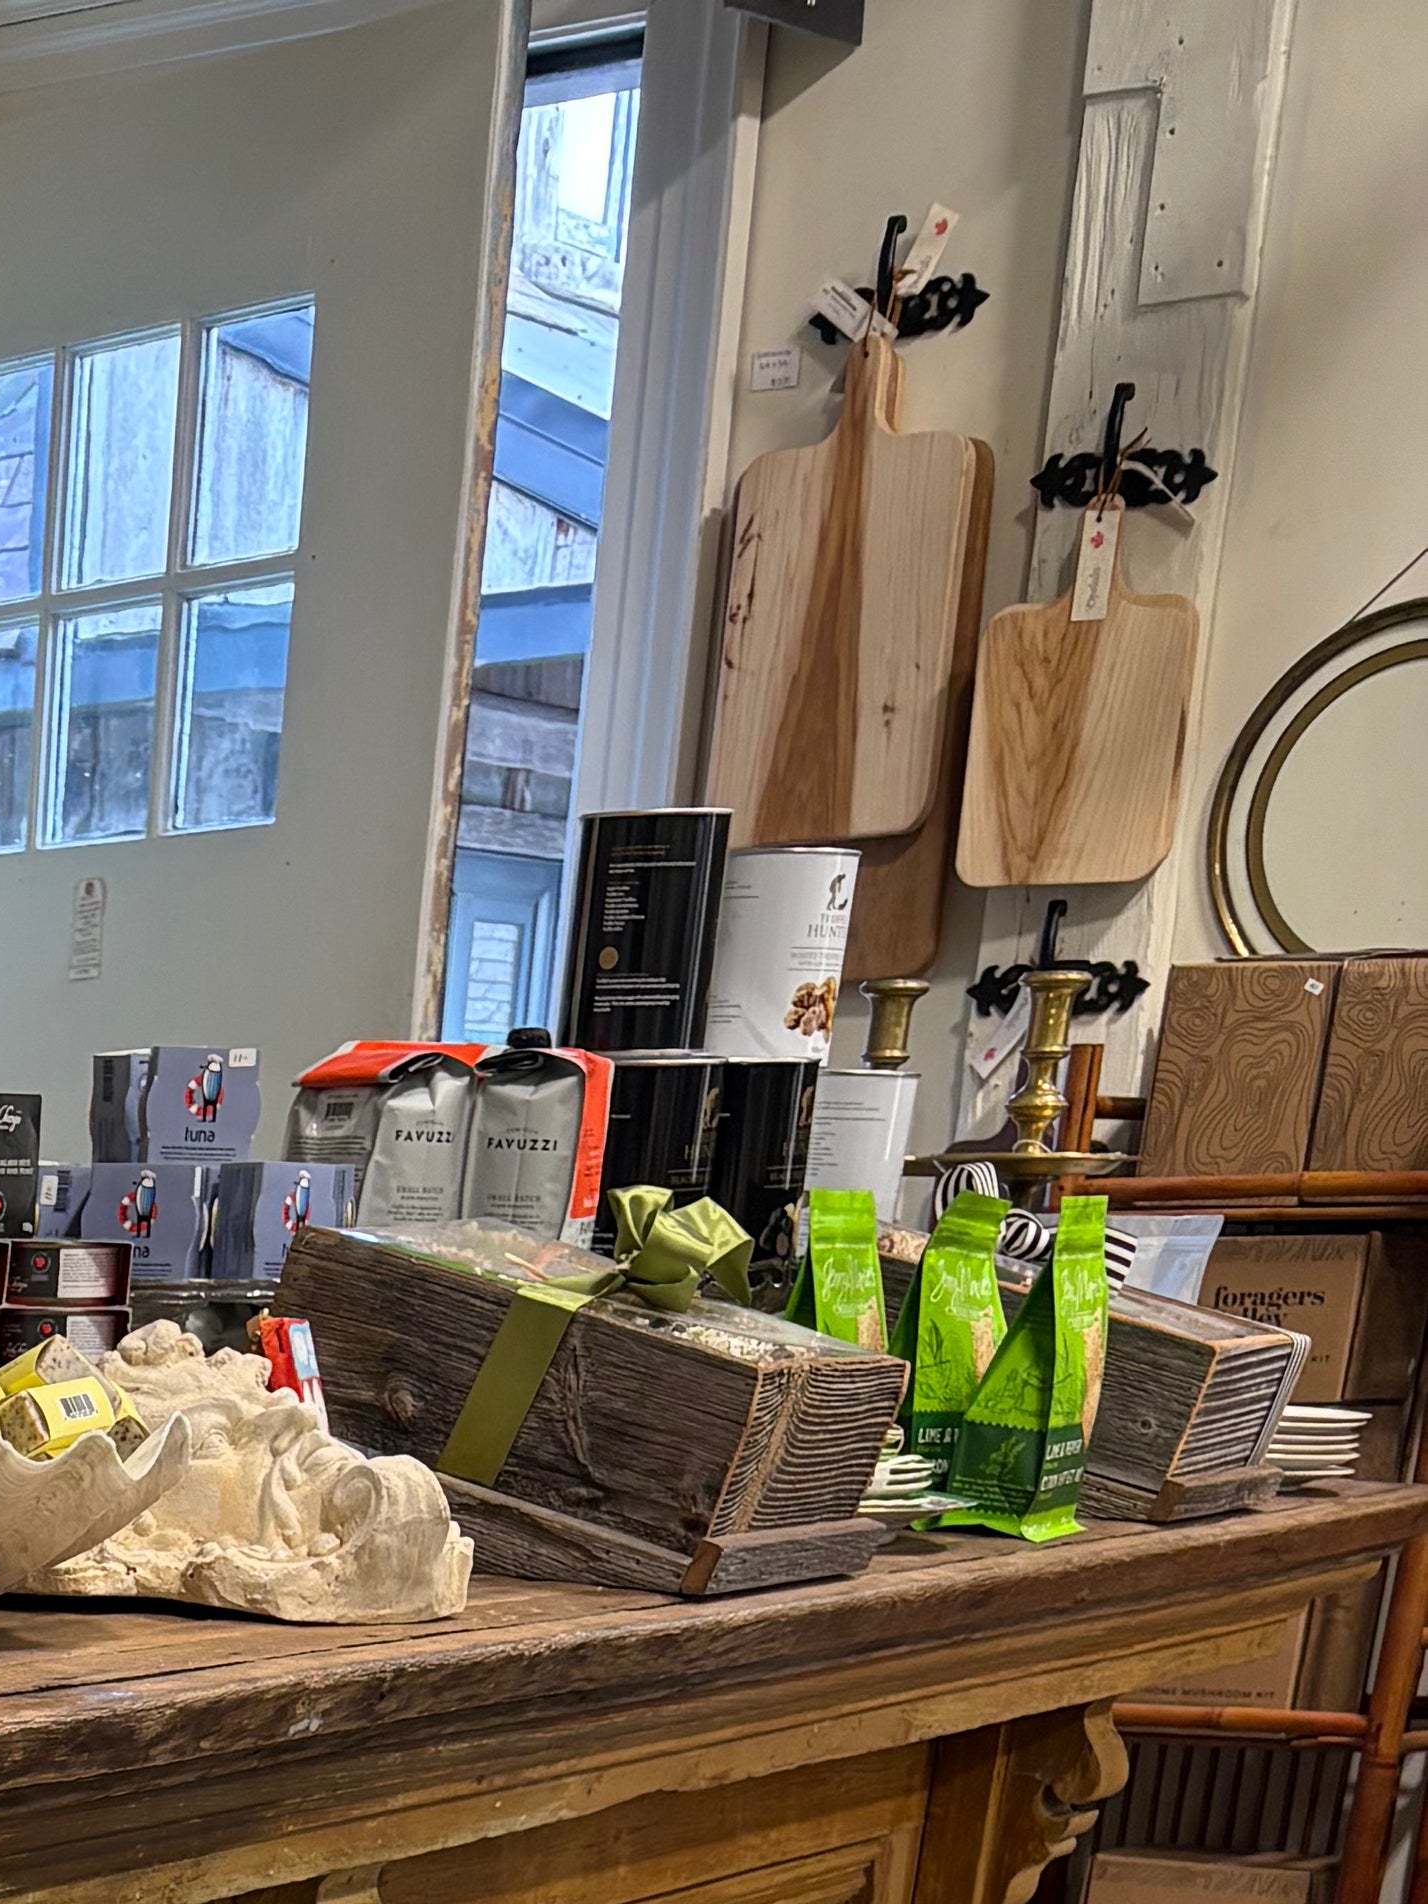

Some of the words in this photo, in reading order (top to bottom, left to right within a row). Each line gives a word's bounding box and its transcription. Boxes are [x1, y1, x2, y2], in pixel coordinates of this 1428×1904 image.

[487, 1136, 559, 1152] FAVUZZI
[1213, 1284, 1327, 1313] foragers
[917, 1427, 942, 1444] LIME
[1181, 1687, 1253, 1699] MUSHROOM
